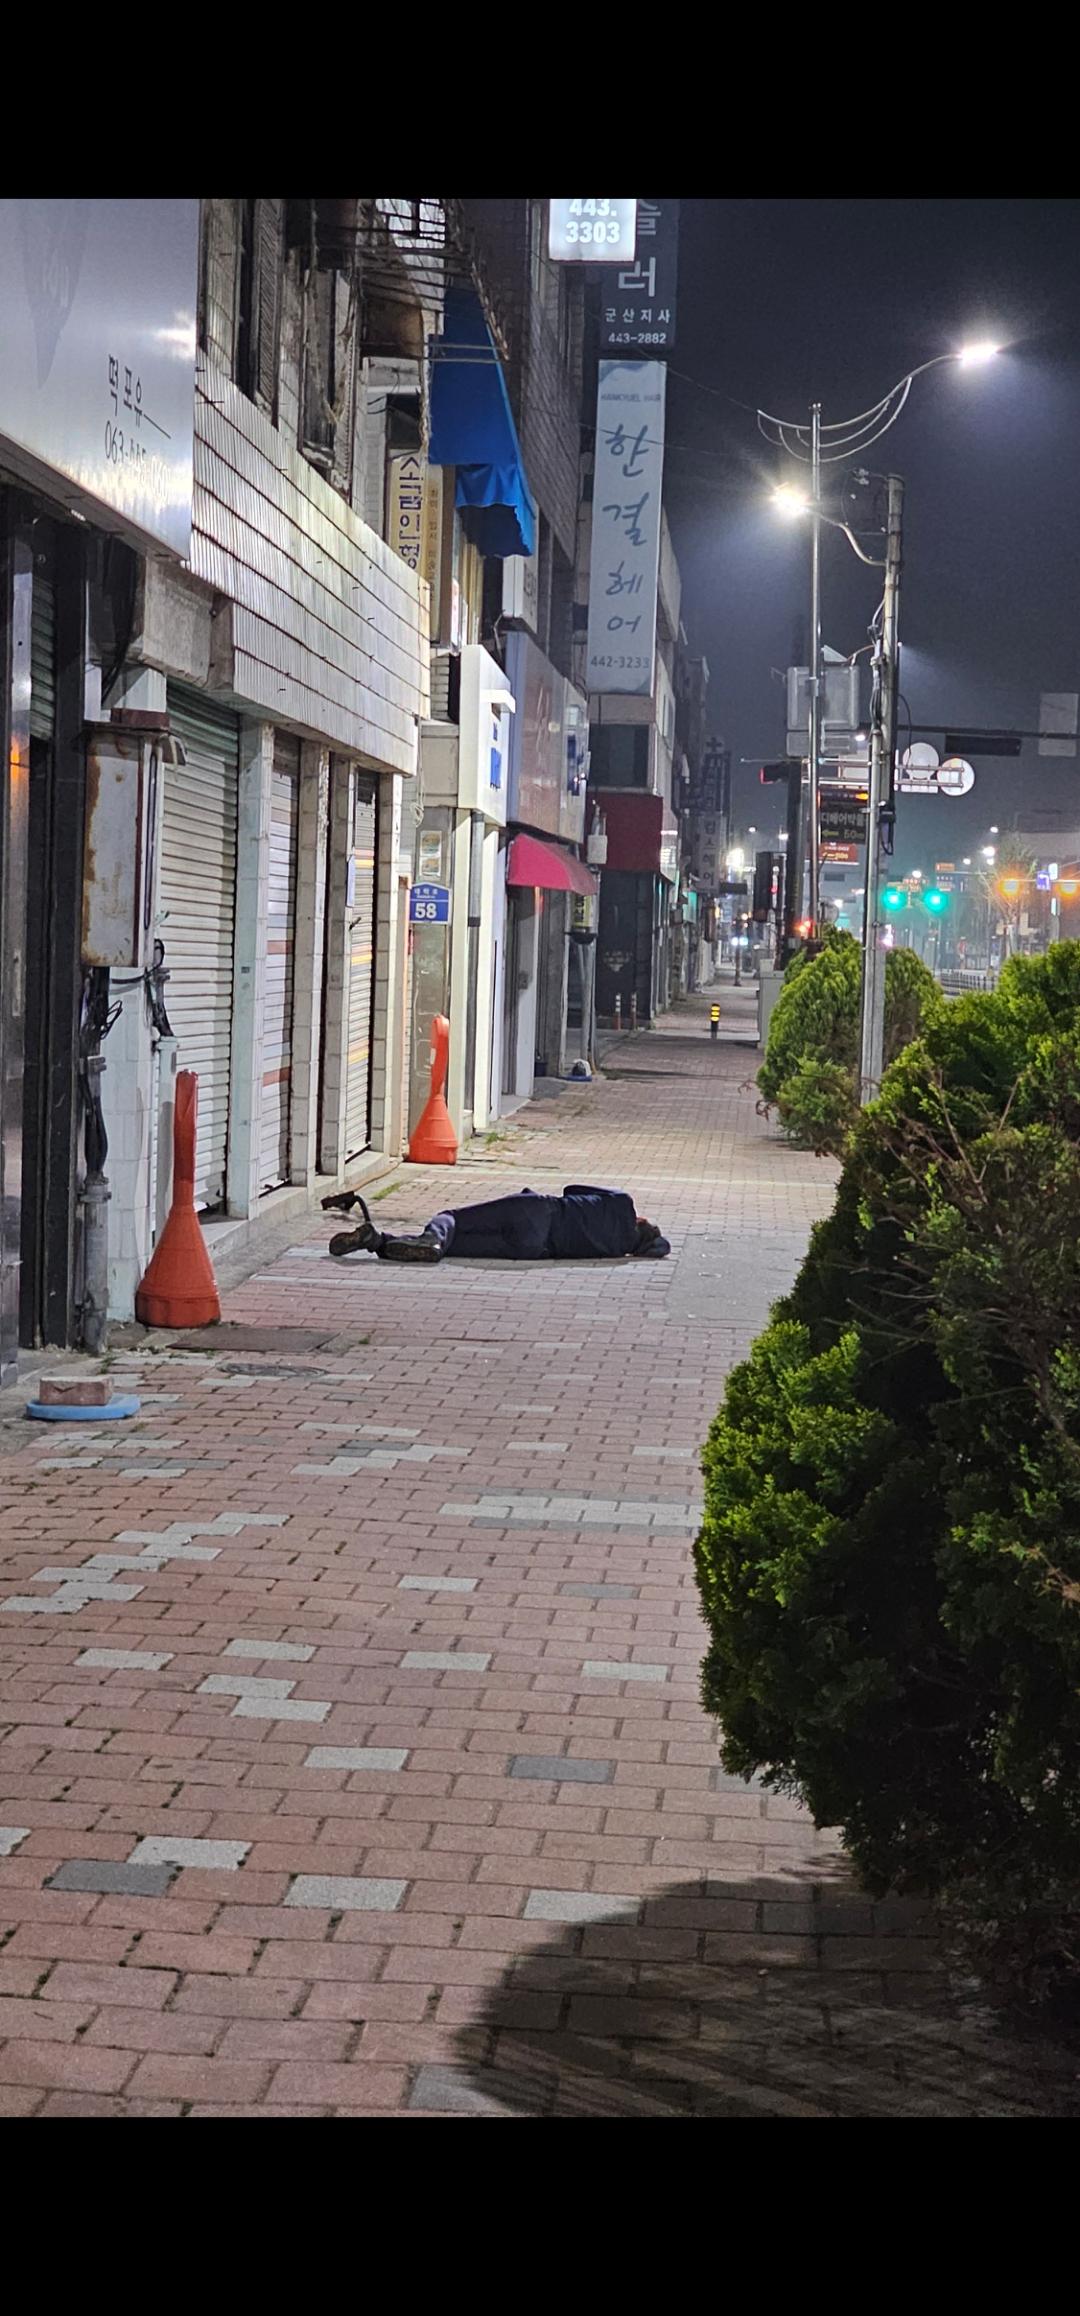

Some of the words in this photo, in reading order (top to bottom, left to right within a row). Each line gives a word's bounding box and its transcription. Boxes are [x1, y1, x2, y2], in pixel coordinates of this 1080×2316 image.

[565, 221, 621, 244] 3303
[605, 308, 671, 324] 군산지사
[608, 332, 667, 344] 443-2882
[590, 655, 650, 669] 442-3233
[414, 902, 437, 919] 58
